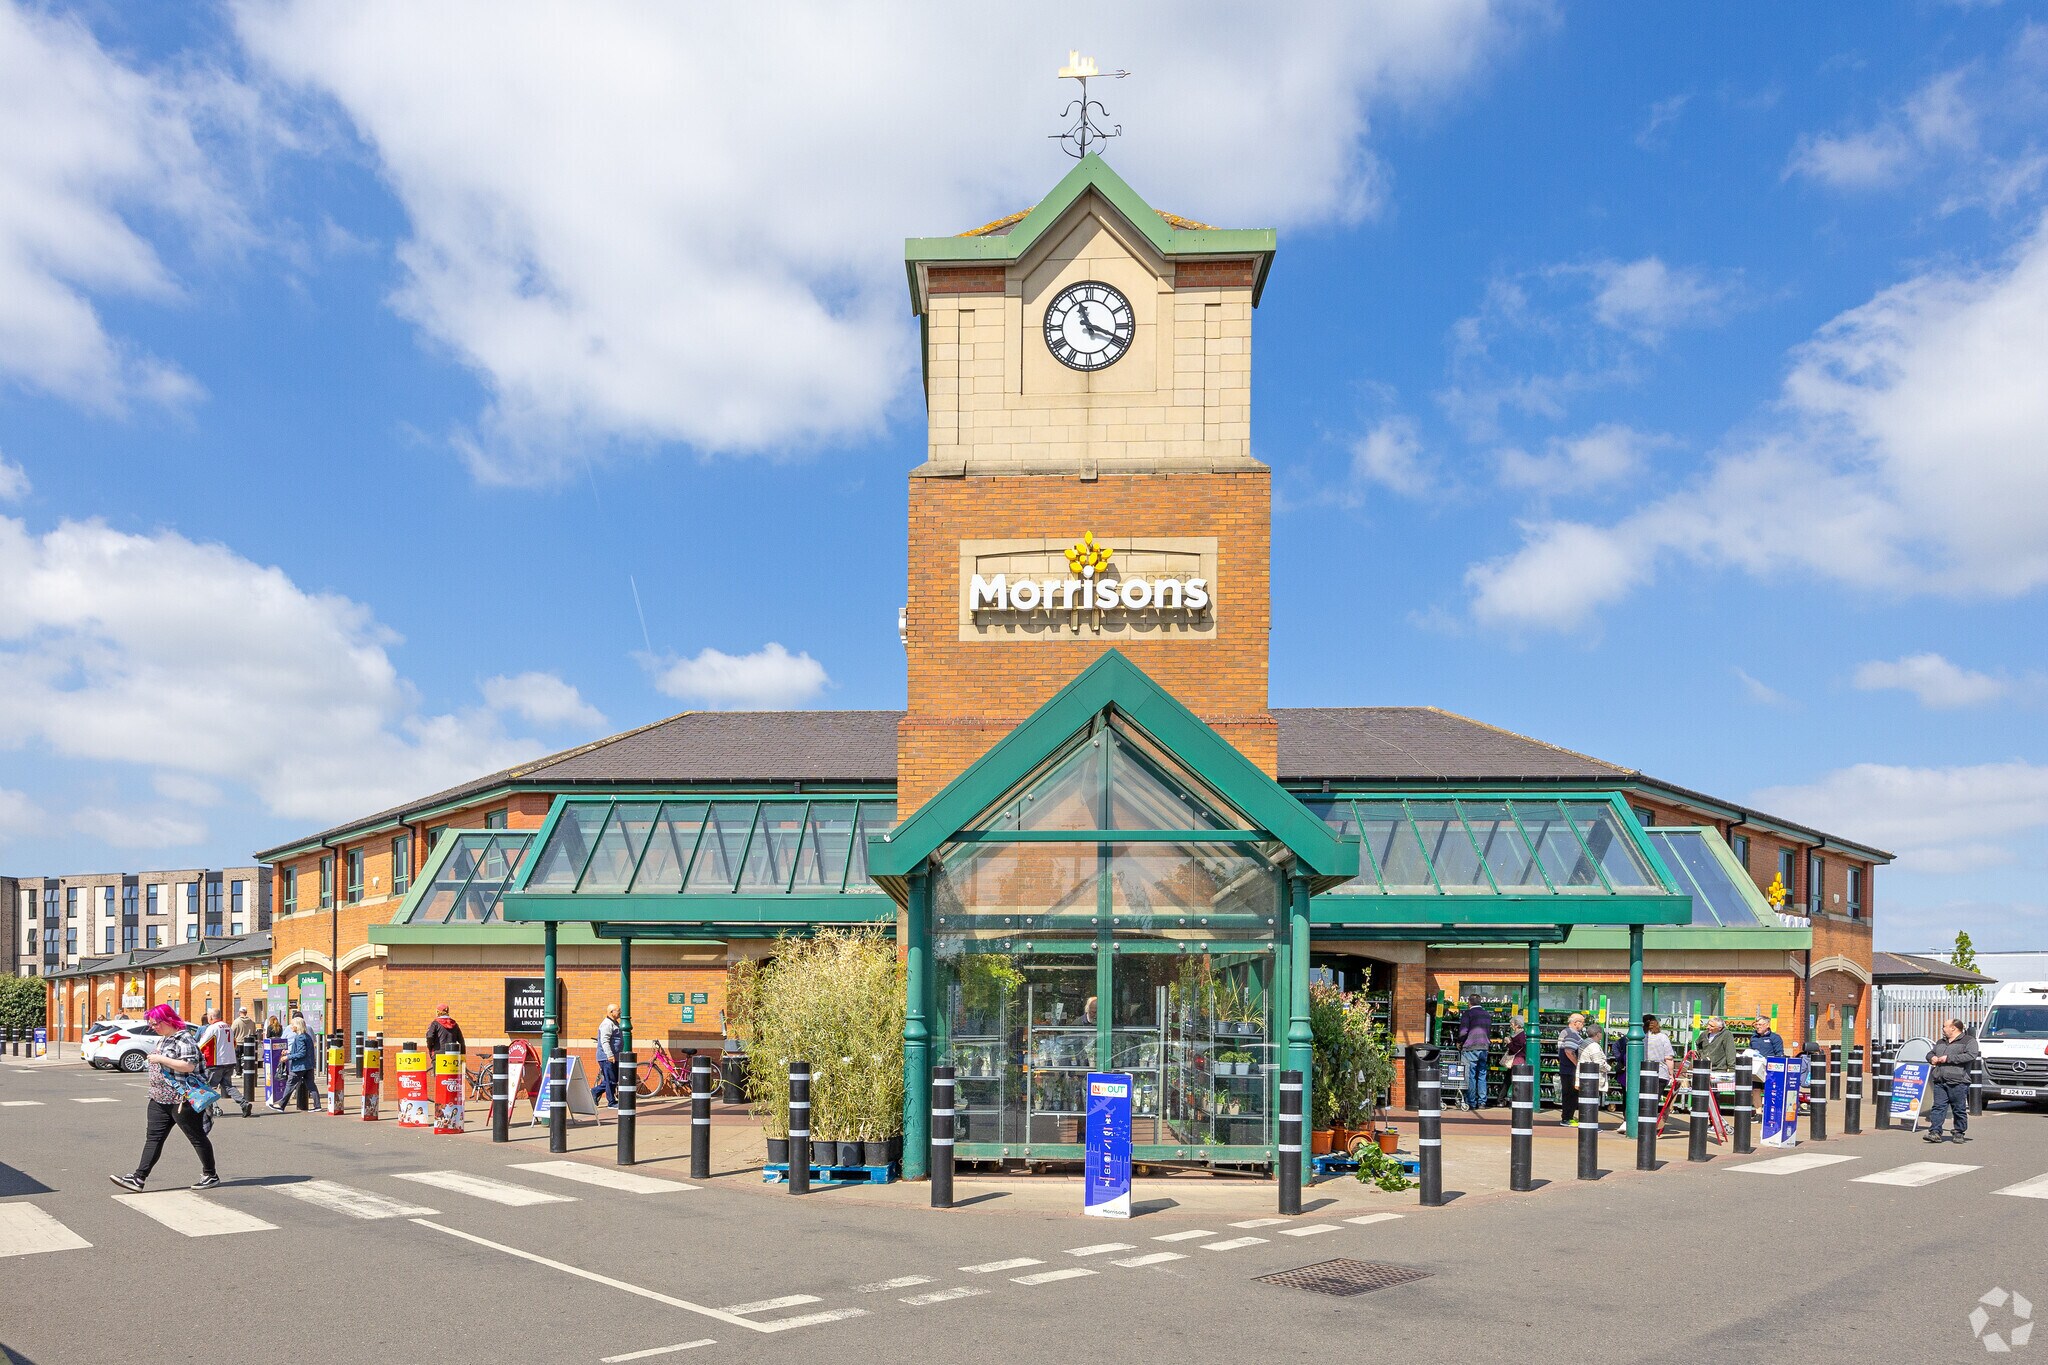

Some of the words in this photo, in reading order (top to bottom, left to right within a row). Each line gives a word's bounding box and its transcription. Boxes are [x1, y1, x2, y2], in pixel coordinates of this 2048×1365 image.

[970, 573, 1209, 611] Morrisons
[514, 997, 544, 1006] MARKE
[514, 1009, 544, 1018] KITCHE
[225, 1029, 230, 1042] 7
